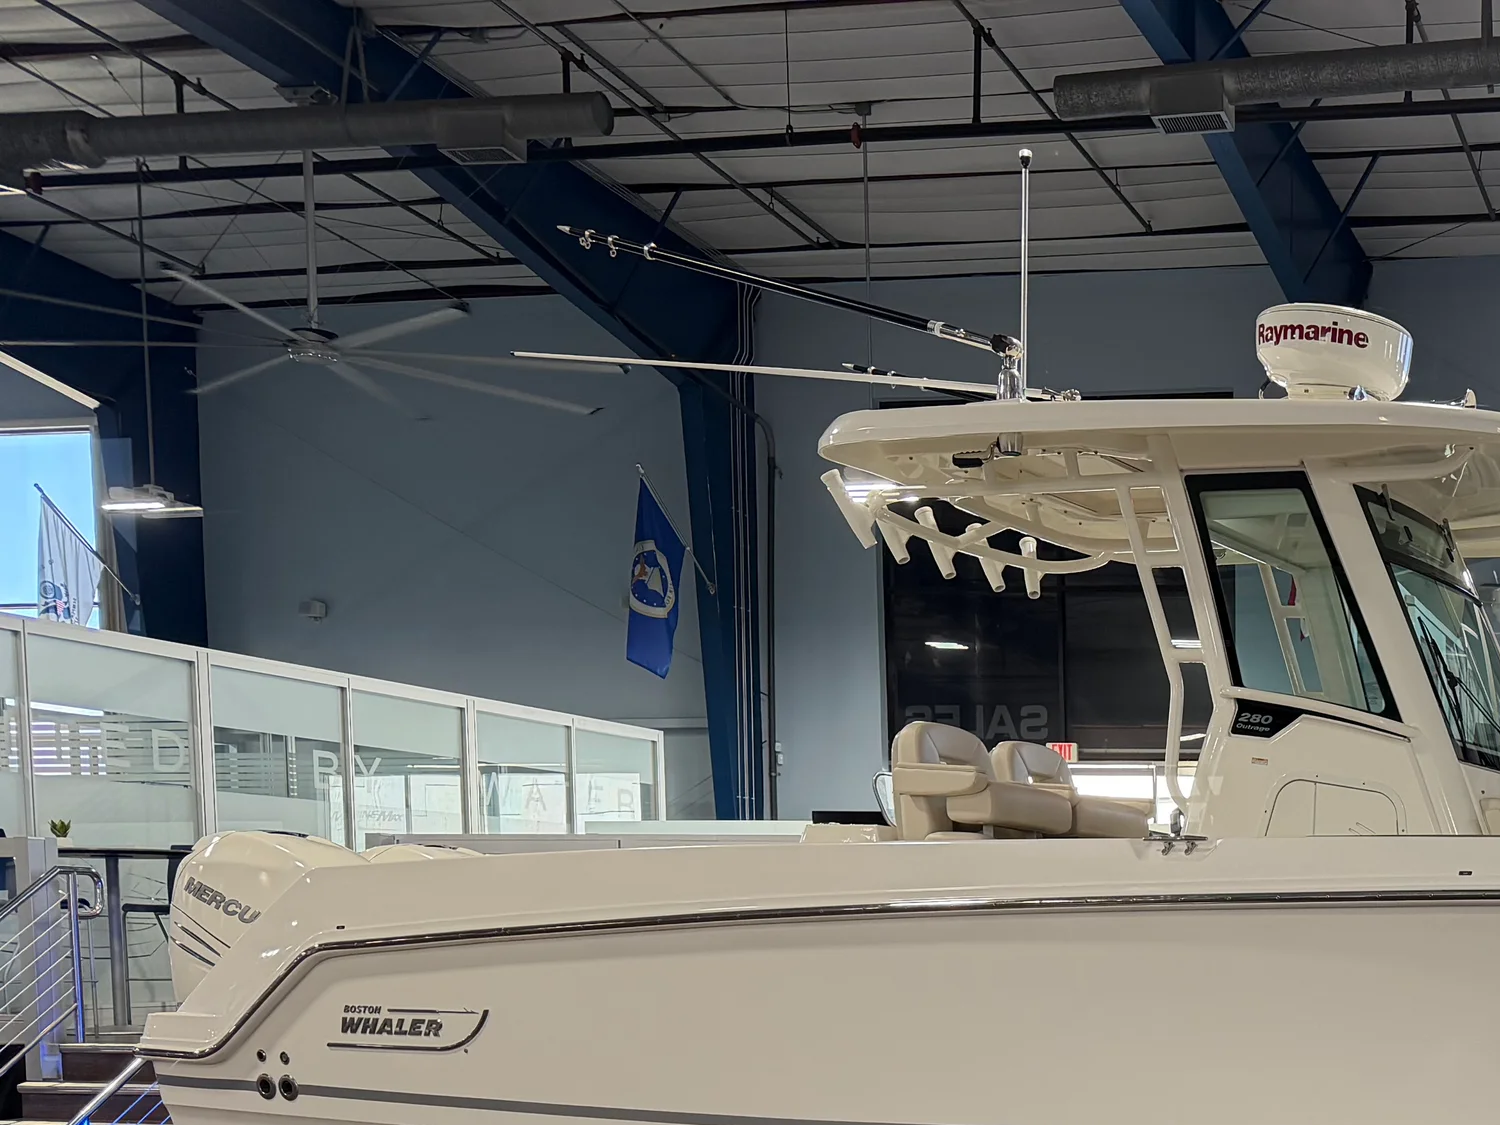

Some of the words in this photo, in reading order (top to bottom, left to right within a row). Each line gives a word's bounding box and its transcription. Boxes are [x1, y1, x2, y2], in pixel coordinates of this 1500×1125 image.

[1258, 321, 1369, 348] Raymarine
[1236, 722, 1271, 732] Outrage
[1238, 712, 1273, 725] 280
[478, 769, 635, 819] WAER
[183, 876, 262, 924] MERCU
[343, 1005, 382, 1015] BOSTON
[341, 1016, 443, 1037] WHALER
